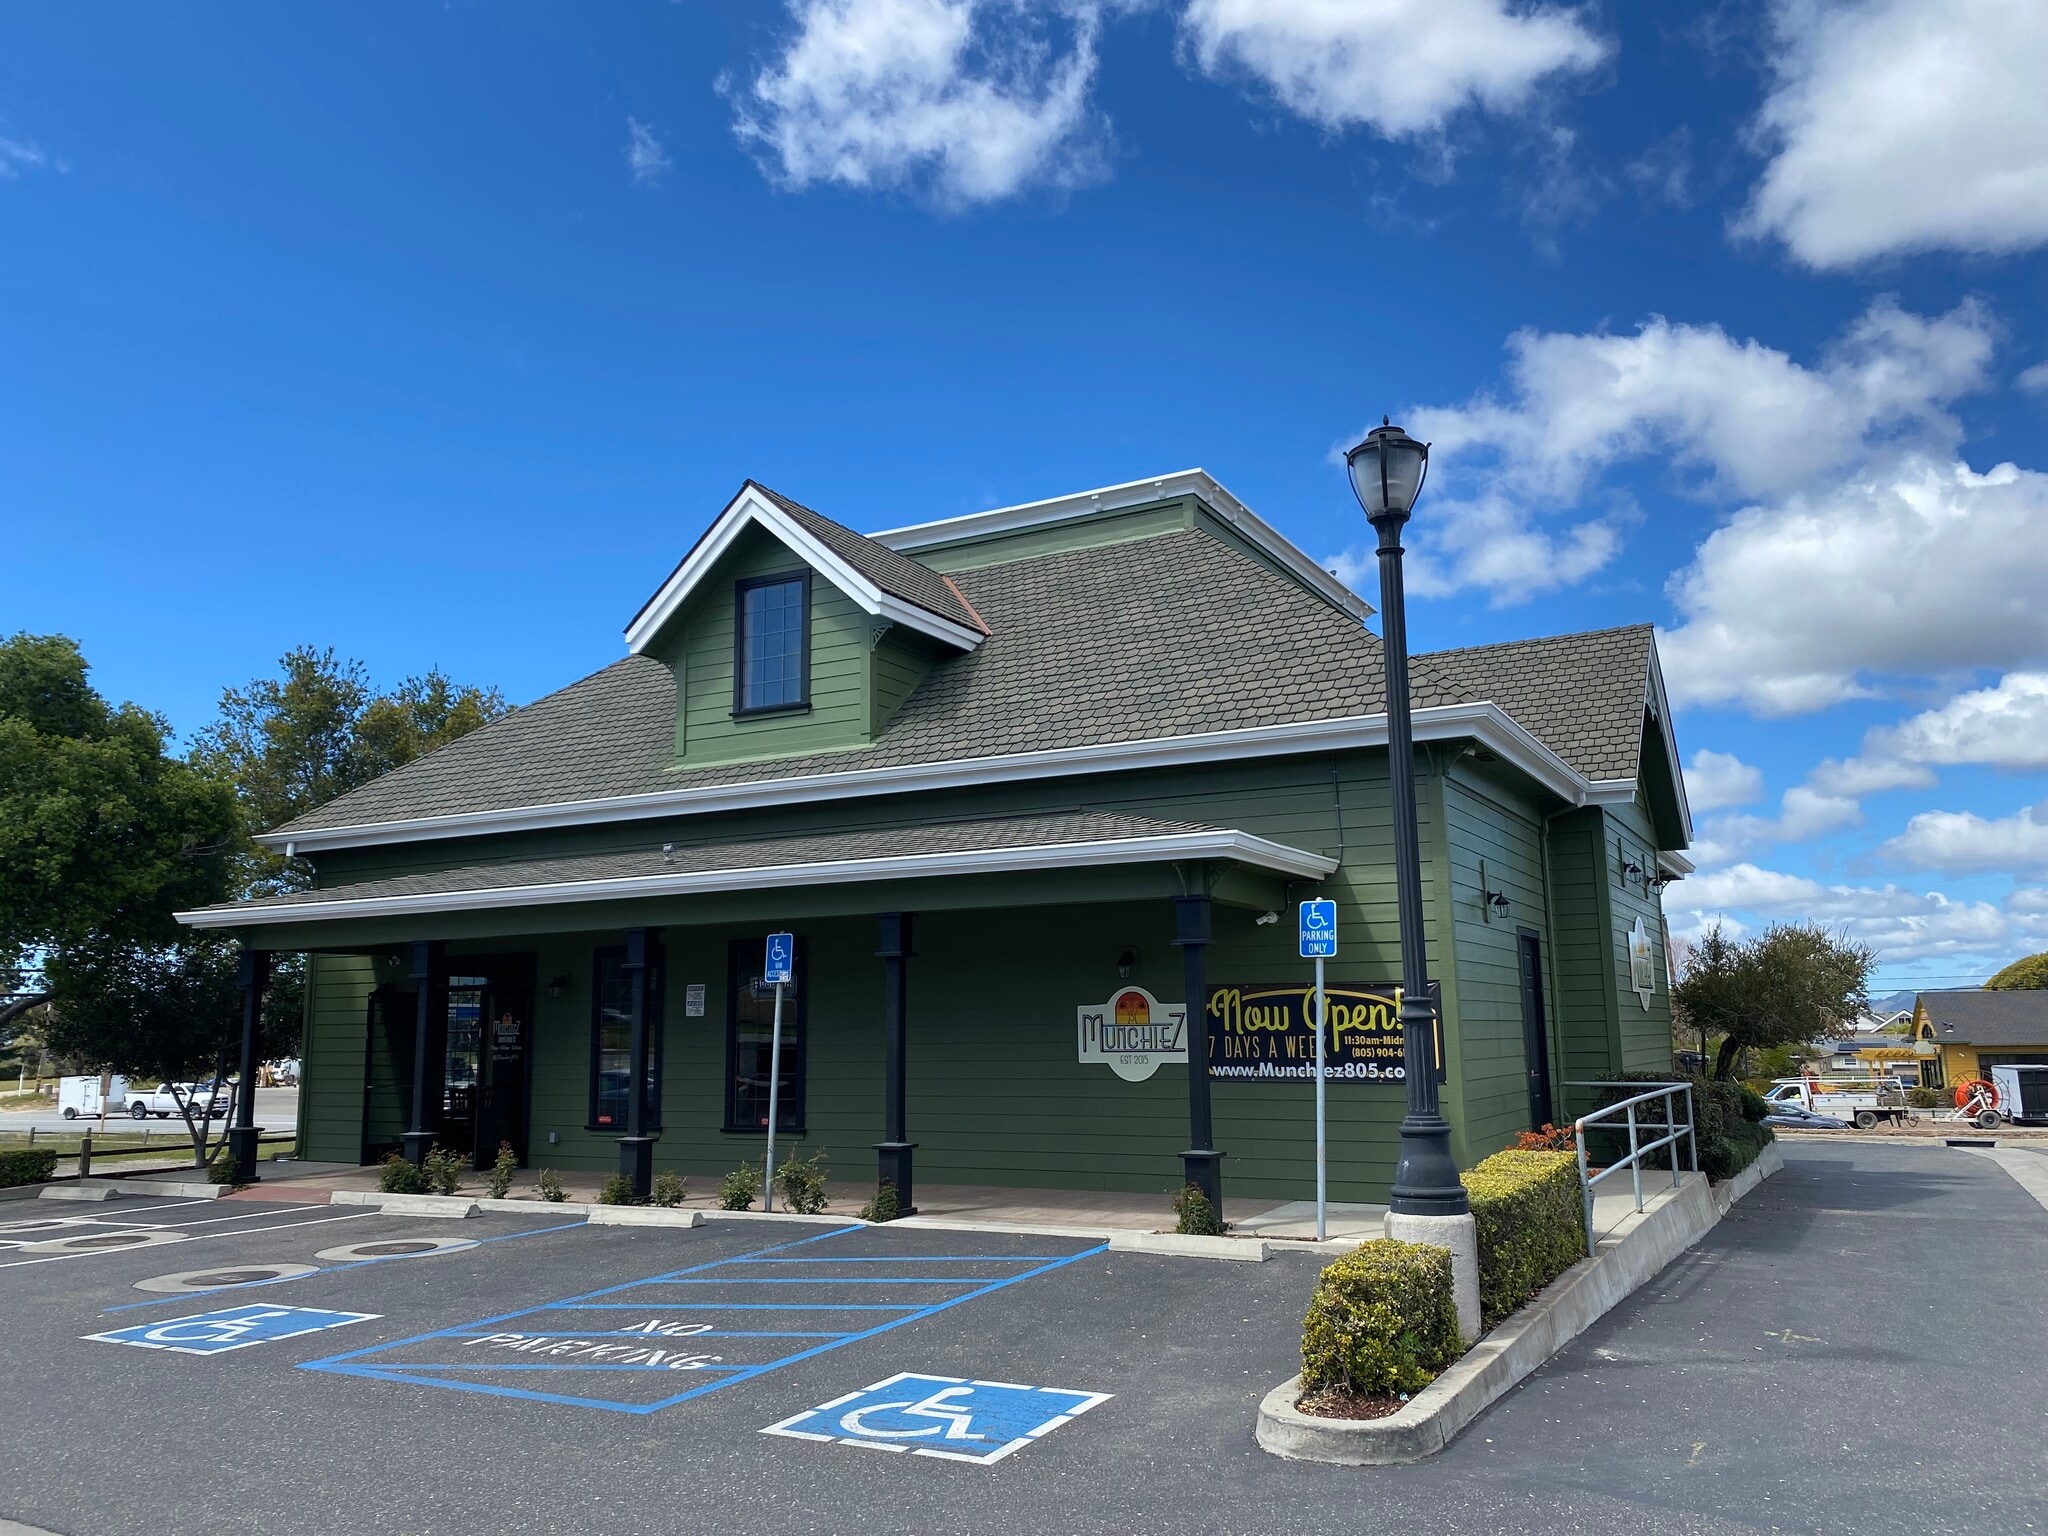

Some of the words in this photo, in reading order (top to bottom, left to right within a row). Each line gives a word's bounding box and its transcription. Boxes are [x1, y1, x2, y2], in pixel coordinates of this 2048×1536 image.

[1302, 929, 1334, 941] PARKING
[1308, 942, 1328, 954] ONLY
[1211, 988, 1290, 1035] Now
[1302, 986, 1404, 1052] Open!
[1082, 1012, 1186, 1053] MUNCHIEZ
[1208, 1035, 1216, 1058] 7
[1224, 1035, 1260, 1058] DAYS
[1268, 1035, 1278, 1058] A
[1352, 1046, 1375, 1059] (805)
[1120, 1055, 1132, 1065] EST
[1134, 1054, 1149, 1065] 2015
[1212, 1061, 1406, 1079] www.Munchez805.co
[612, 1319, 714, 1337] NO
[462, 1333, 723, 1370] PARKING
